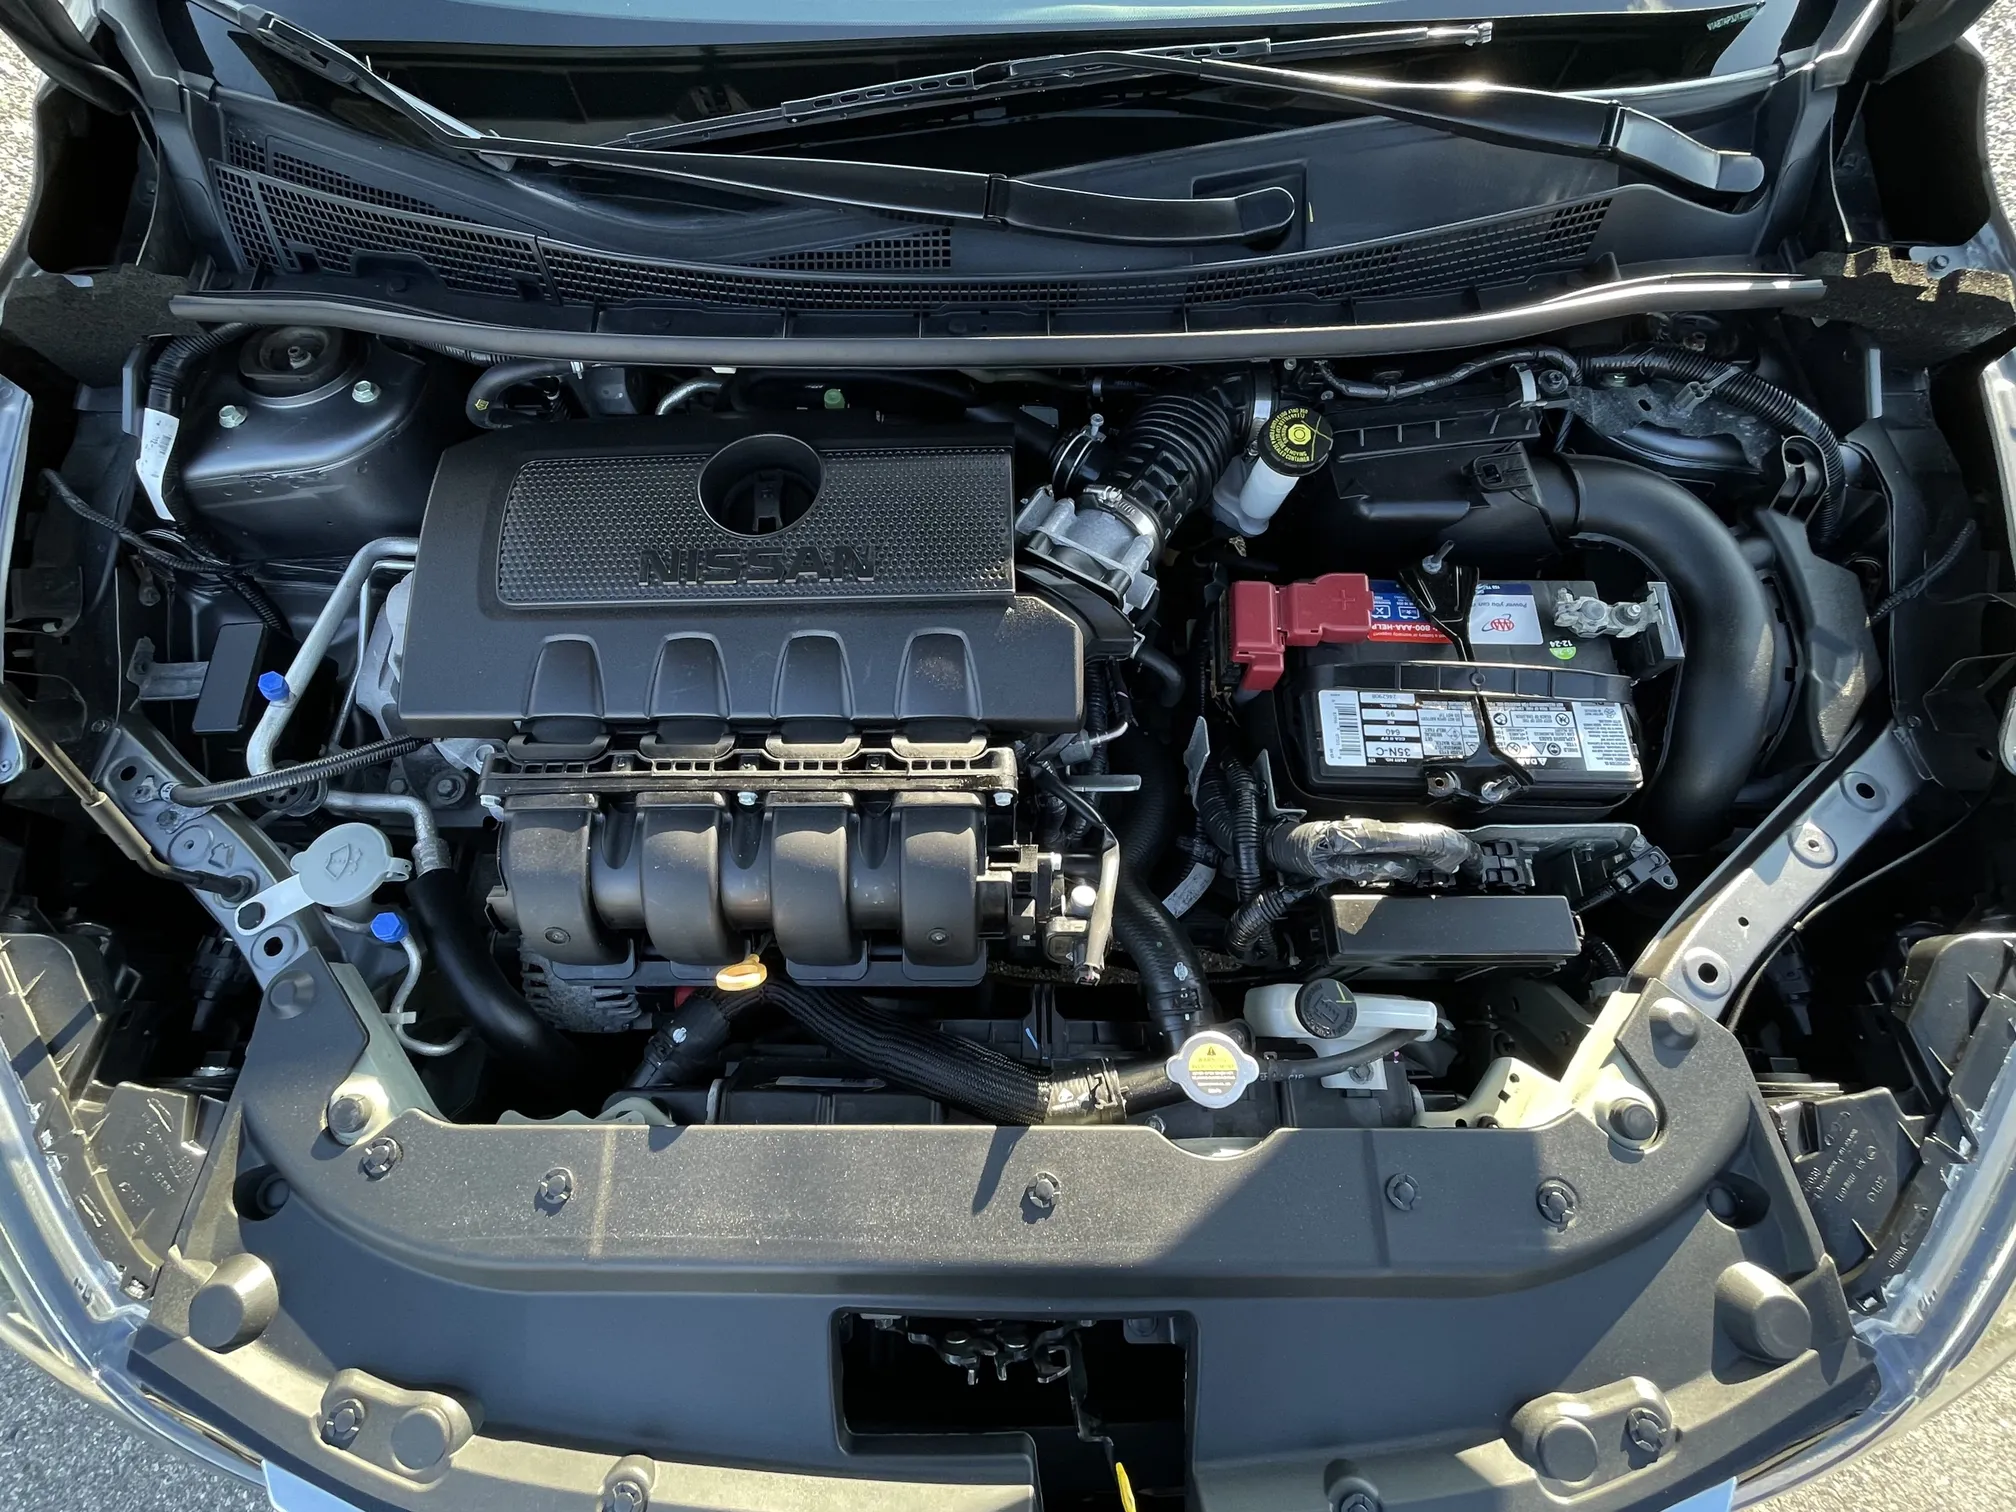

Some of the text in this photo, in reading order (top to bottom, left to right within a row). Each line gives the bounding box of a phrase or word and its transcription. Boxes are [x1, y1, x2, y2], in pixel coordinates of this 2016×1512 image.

[638, 546, 875, 586] NISSAN
[1494, 621, 1511, 630] AAA
[1376, 747, 1411, 757] 35N-C
[1888, 1246, 1908, 1269] CHINA
